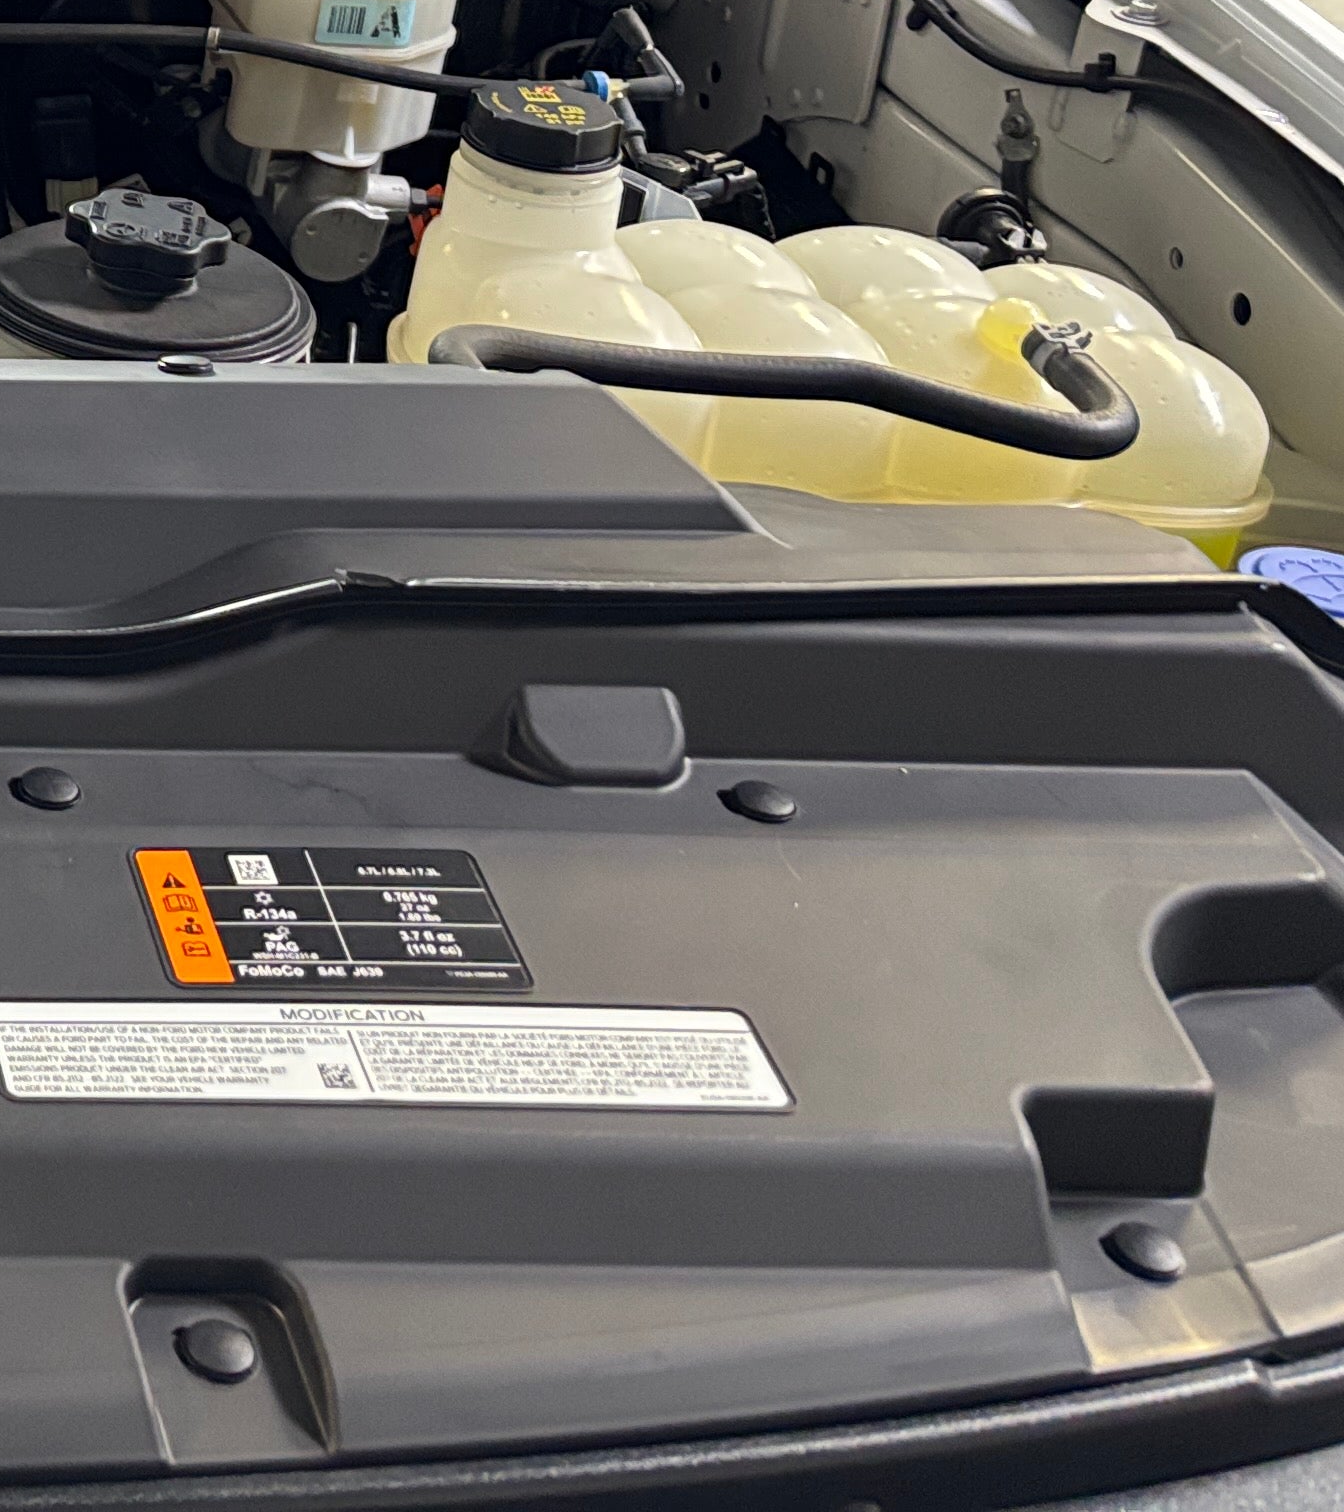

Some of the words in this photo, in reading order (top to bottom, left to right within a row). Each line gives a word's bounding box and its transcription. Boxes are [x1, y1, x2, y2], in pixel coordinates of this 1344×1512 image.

[370, 6, 400, 38] A
[419, 893, 438, 904] kg
[243, 908, 297, 920] R-134a
[399, 931, 420, 942] 3.7
[423, 931, 435, 941] fl
[436, 932, 456, 942] oz
[265, 940, 300, 952] PAG
[406, 944, 437, 956] (110
[439, 945, 463, 957] cc)
[238, 964, 305, 977] FoMoCo
[317, 967, 347, 977] SAE
[279, 1008, 425, 1021] MODIFICATION
